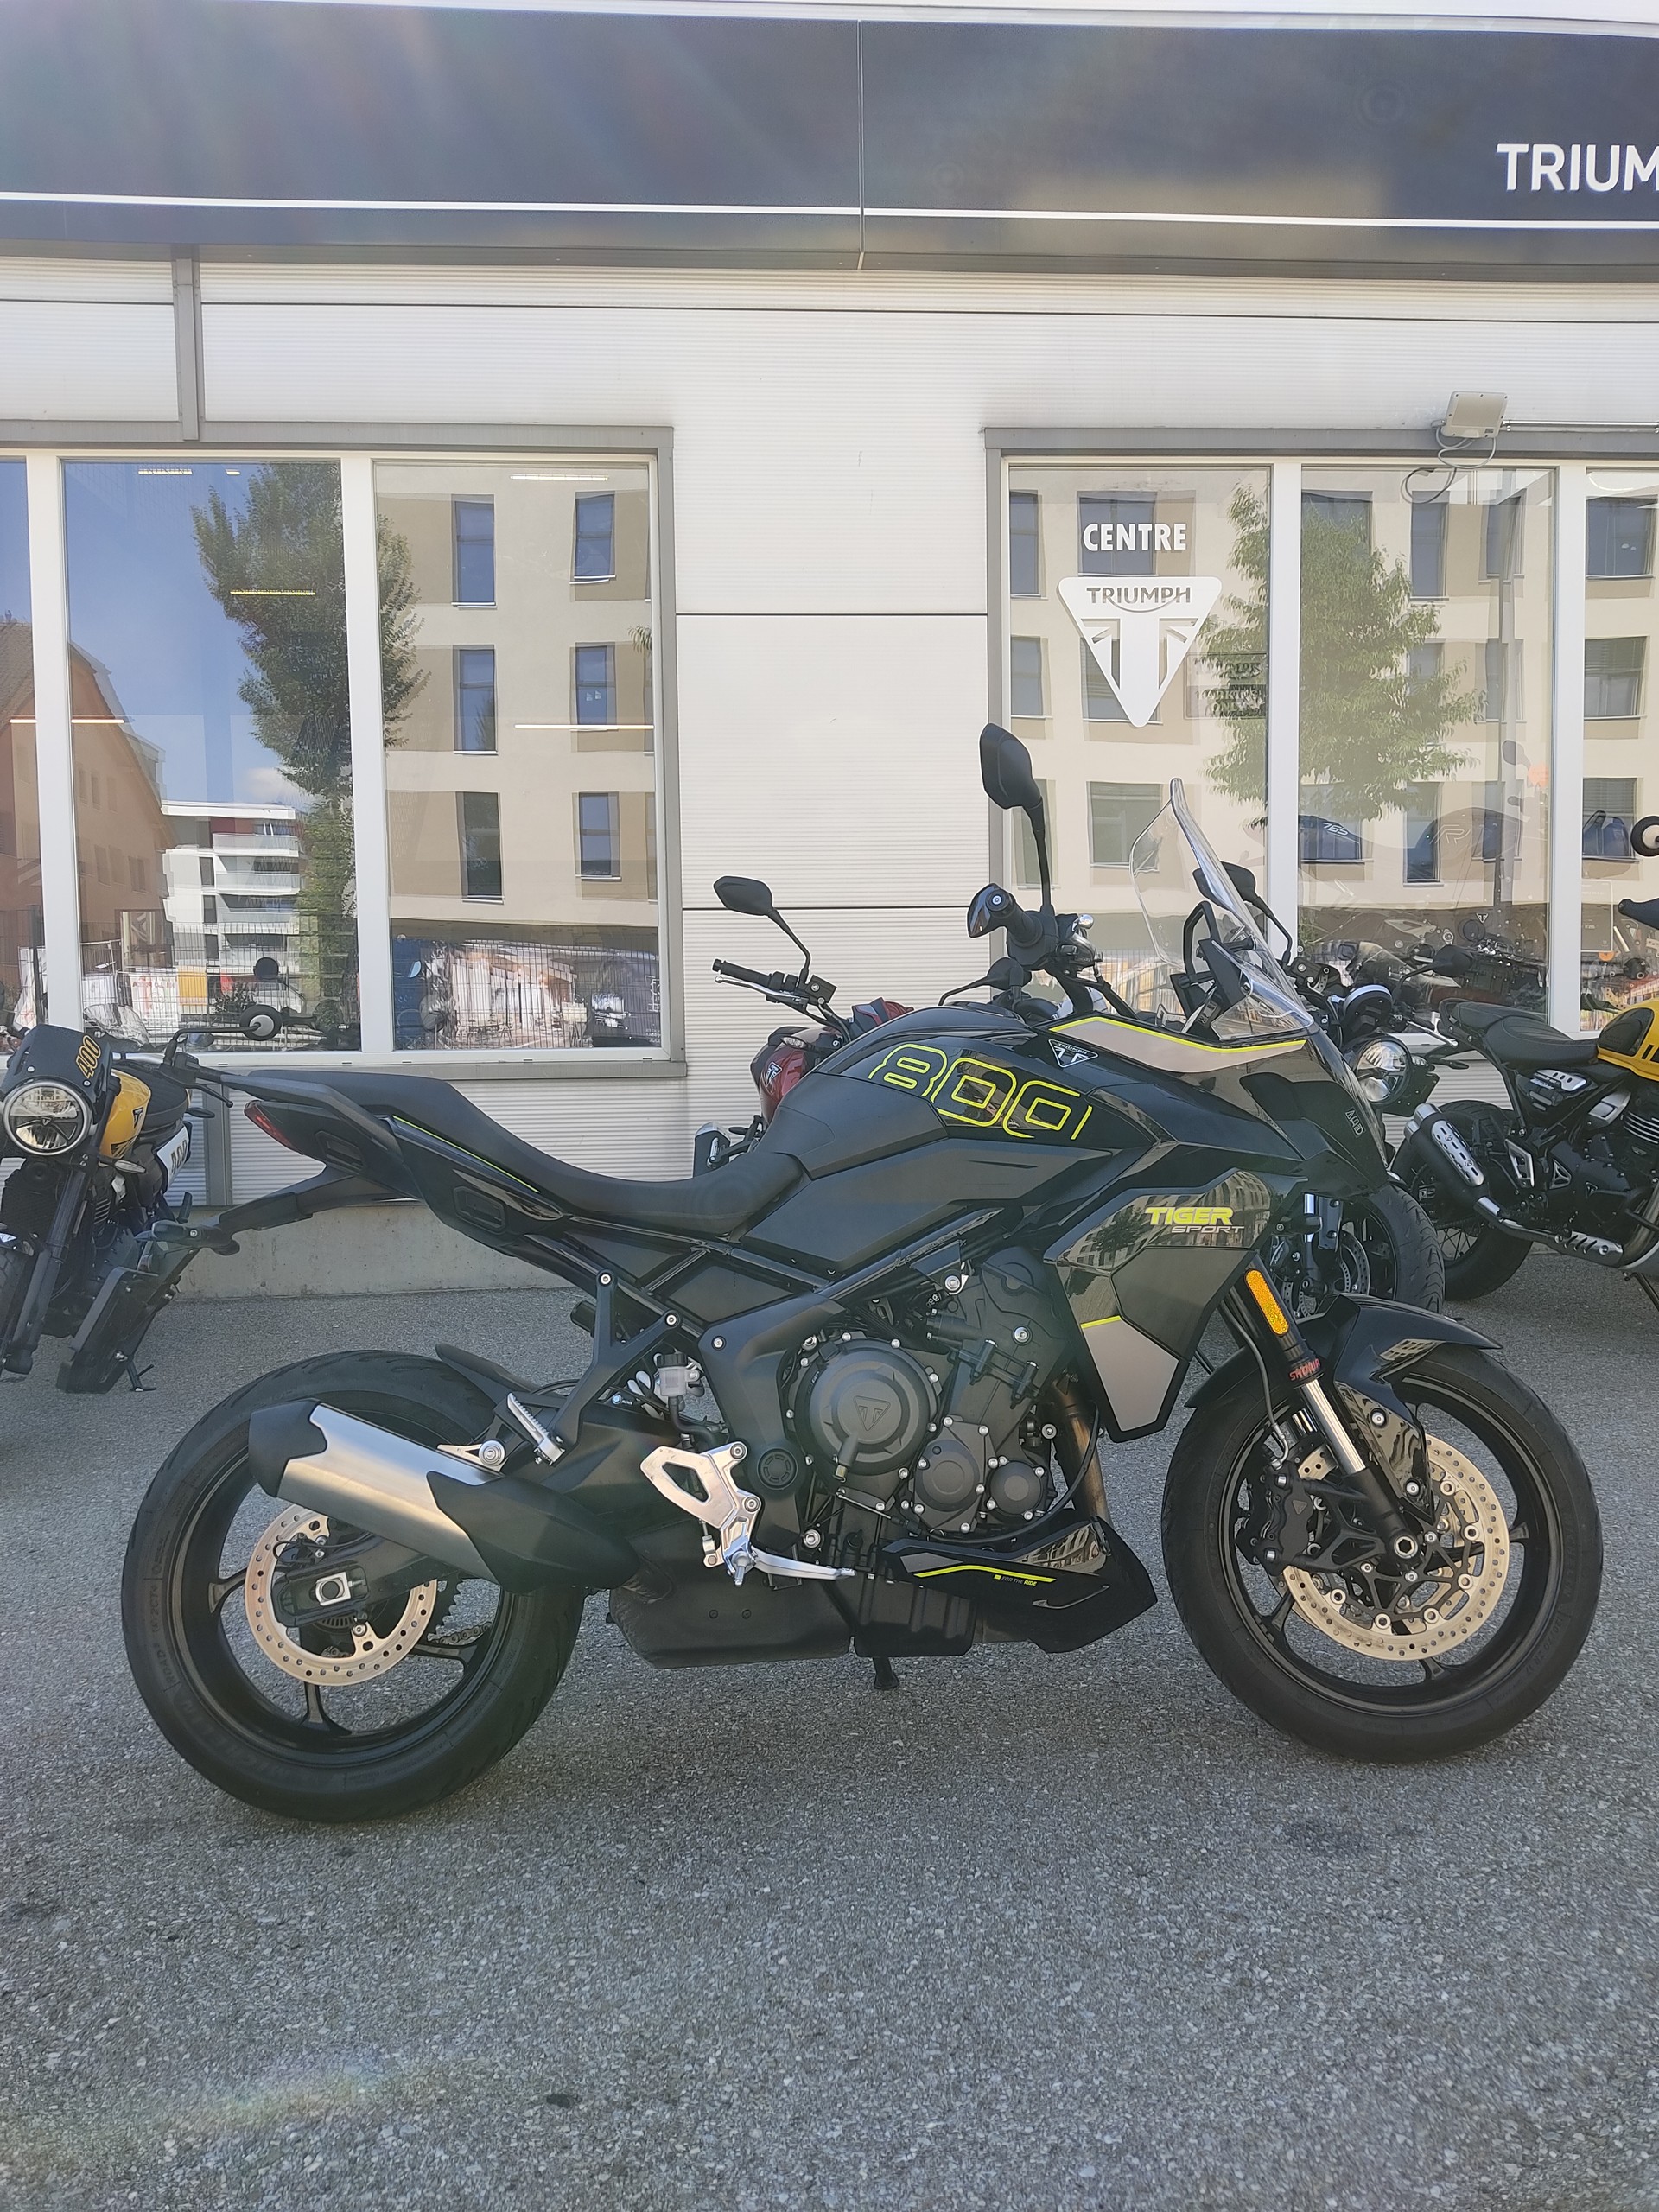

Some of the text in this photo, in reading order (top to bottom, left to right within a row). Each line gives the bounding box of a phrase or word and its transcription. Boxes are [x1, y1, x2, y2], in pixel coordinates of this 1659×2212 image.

[1083, 522, 1188, 552] CENTRE
[1086, 587, 1192, 607] TRIUMPH
[1322, 822, 1349, 836] 765
[75, 1034, 101, 1079] 400
[868, 1043, 1093, 1141] 800
[1145, 1206, 1234, 1226] TIGER
[1171, 1225, 1245, 1234] SPORT
